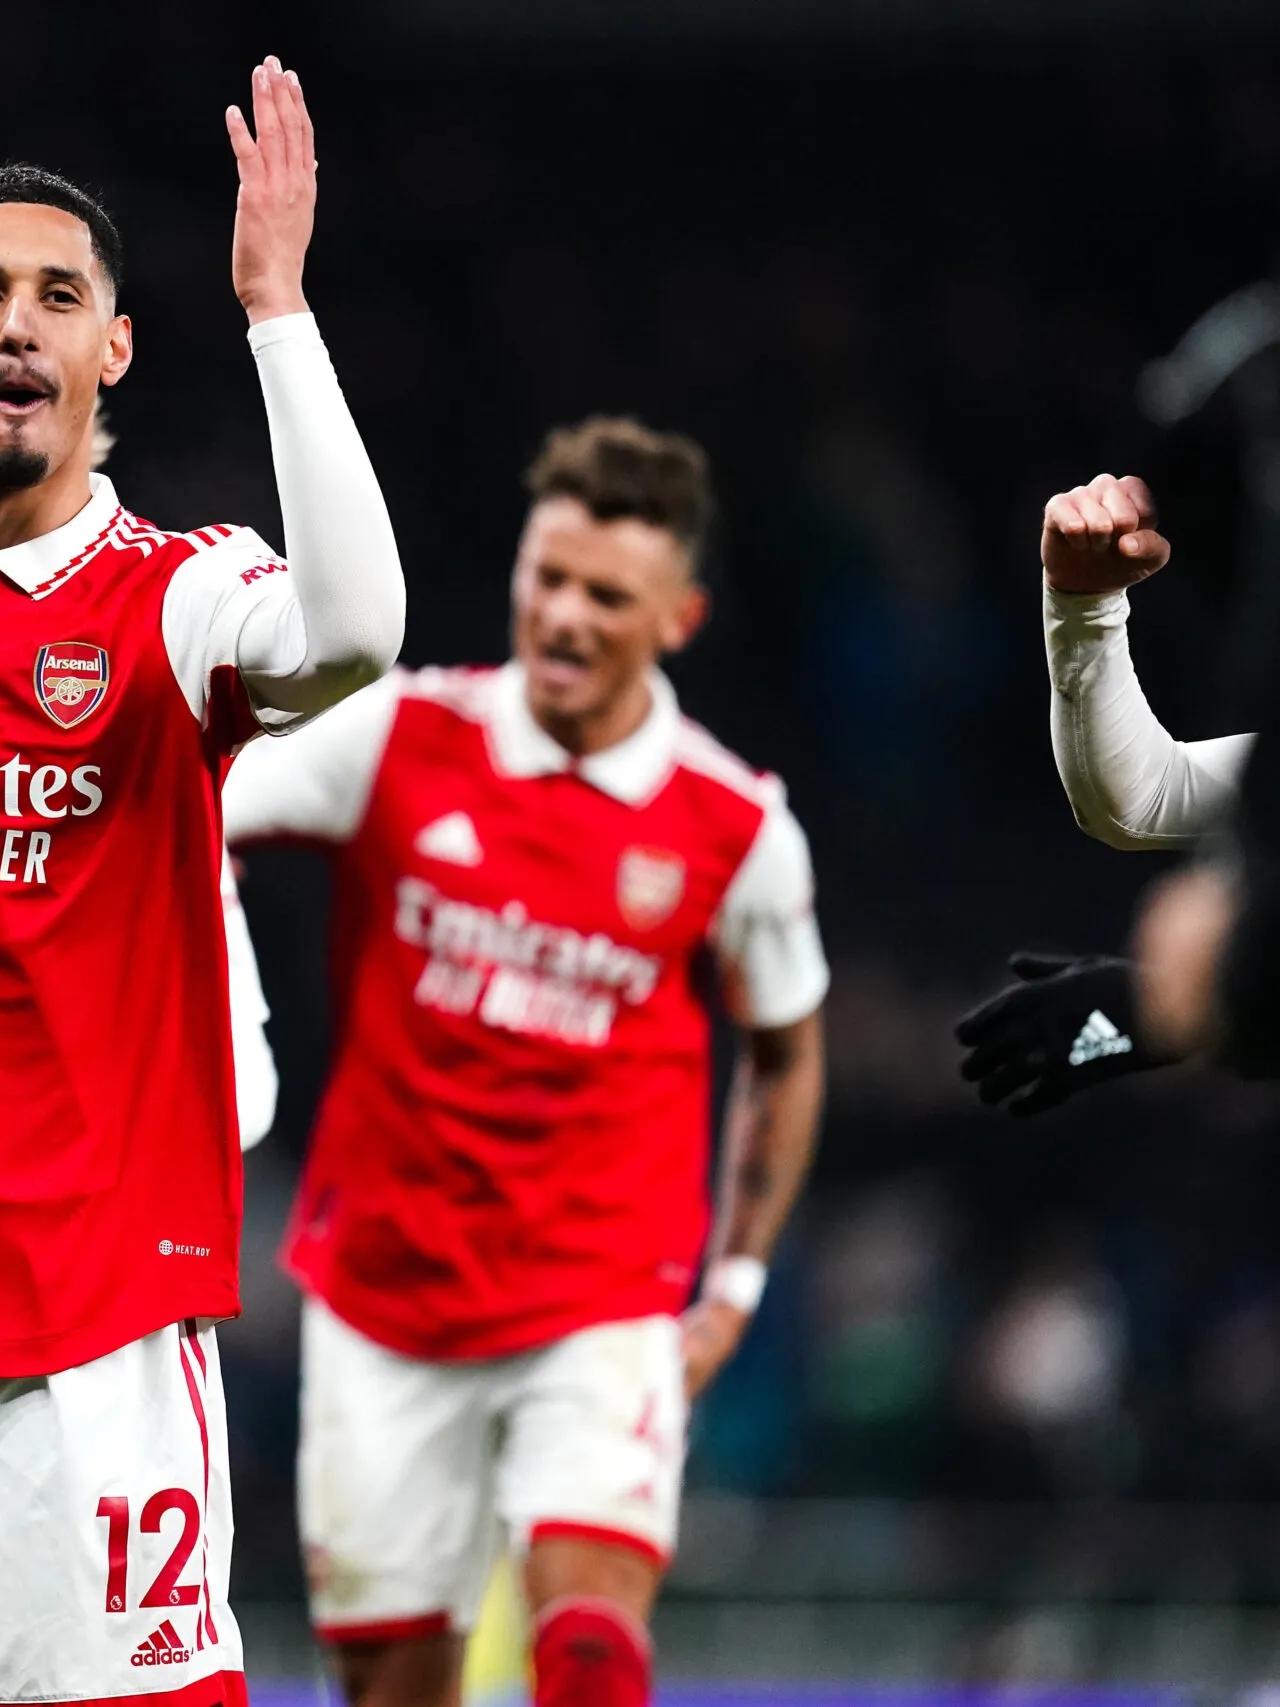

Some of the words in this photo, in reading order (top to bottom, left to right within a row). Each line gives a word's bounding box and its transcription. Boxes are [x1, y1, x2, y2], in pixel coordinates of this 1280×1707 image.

[45, 655, 100, 672] Arsenal
[96, 1487, 201, 1613] 12
[130, 1648, 190, 1667] adidas
